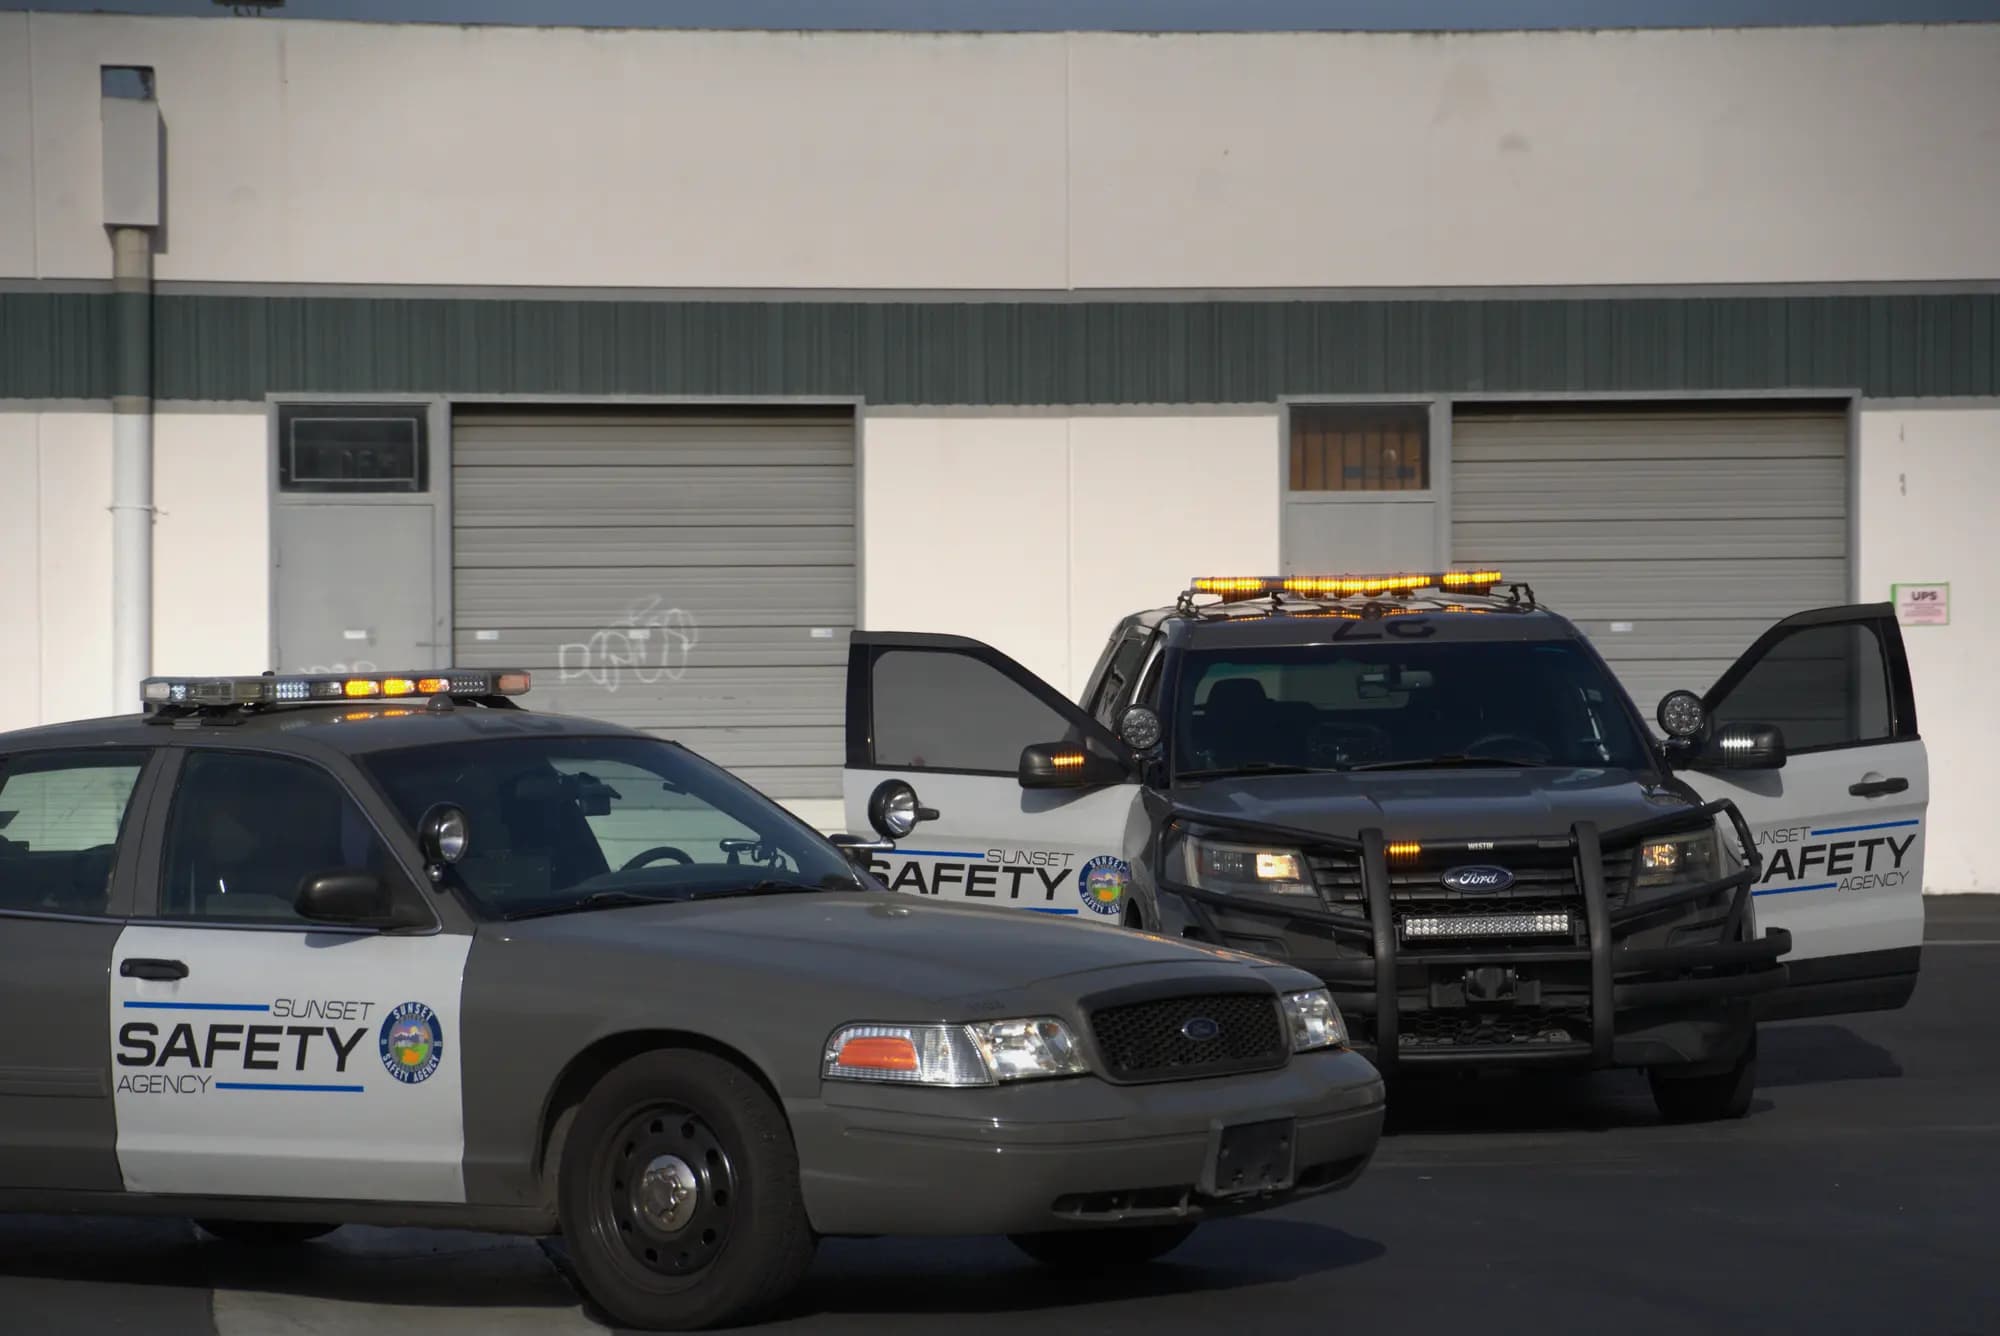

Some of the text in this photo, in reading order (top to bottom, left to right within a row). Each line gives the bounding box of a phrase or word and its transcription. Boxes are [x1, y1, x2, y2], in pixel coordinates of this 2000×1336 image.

[1911, 591, 1937, 601] UPS
[1737, 826, 1811, 847] UNSET
[986, 849, 1075, 867] SUNSET
[1761, 834, 1916, 883] AFETY
[1460, 872, 1498, 884] Ford
[1838, 870, 1910, 892] AGENCY
[272, 998, 375, 1021] SUNSET
[393, 1003, 433, 1020] SUNSET
[117, 1022, 369, 1072] SAFETY
[383, 1053, 439, 1082] SAFETY AGENCY
[117, 1074, 212, 1094] AGENCY
